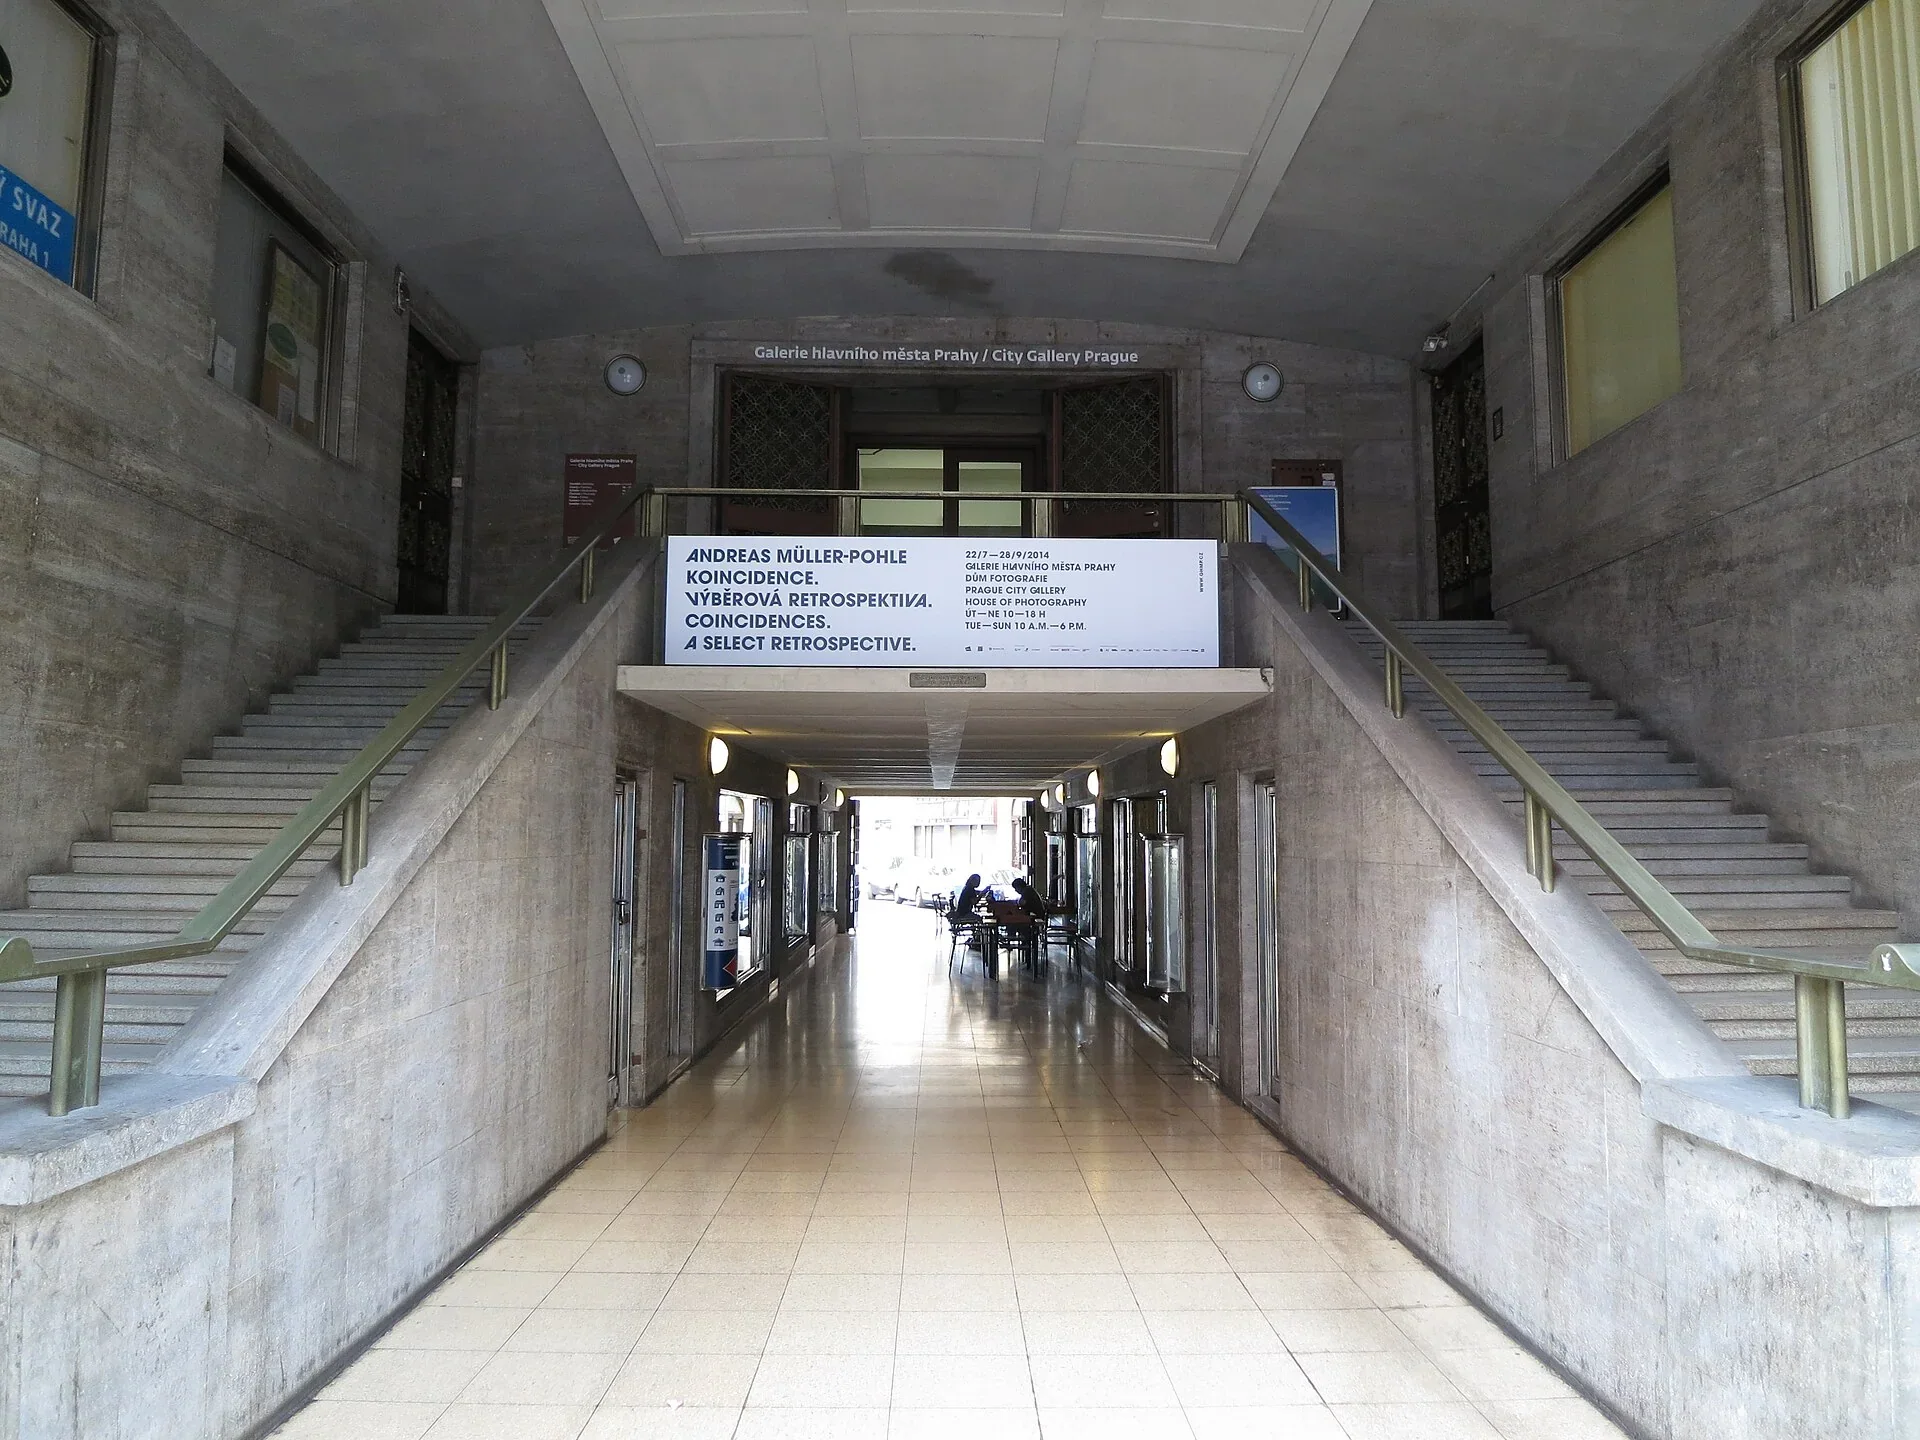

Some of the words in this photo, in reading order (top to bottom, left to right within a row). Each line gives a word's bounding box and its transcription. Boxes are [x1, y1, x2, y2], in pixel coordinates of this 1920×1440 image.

[12, 186, 62, 239] SVAZ
[43, 251, 49, 270] 1
[754, 345, 809, 359] Galerie
[812, 346, 879, 360] hlavního
[882, 347, 931, 361] města
[934, 348, 979, 365] Prahy
[992, 348, 1024, 366] City
[1027, 349, 1082, 367] Gallery
[1084, 350, 1139, 367] Prague
[685, 548, 771, 564] ANDREAS
[776, 545, 907, 564] MÜLLER-POHLE
[965, 562, 1000, 571] GALERIE
[1002, 560, 1049, 571] HLAVNÍHO
[1051, 561, 1082, 572] MĚSTA
[1084, 563, 1116, 572] PRAHY
[686, 568, 819, 586] KOINCIDENCE.
[965, 572, 987, 583] DŮM
[989, 574, 1048, 583] FOTOGRAFIE
[684, 587, 783, 607] VÝBĚROVÁ
[788, 592, 933, 609] RETROSPEKTIVA.
[965, 586, 1003, 595] PRAGUE
[1005, 586, 1027, 595] CITY
[1029, 586, 1067, 595] GALLERY
[965, 597, 997, 606] HOUSE
[999, 598, 1012, 606] OF
[1014, 598, 1087, 607] PHOTOGRAPHY
[685, 613, 831, 629] COINCIDENCES.
[683, 635, 700, 650] A
[702, 635, 766, 651] SELECT
[771, 636, 916, 652] RETROSPECTIVE.
